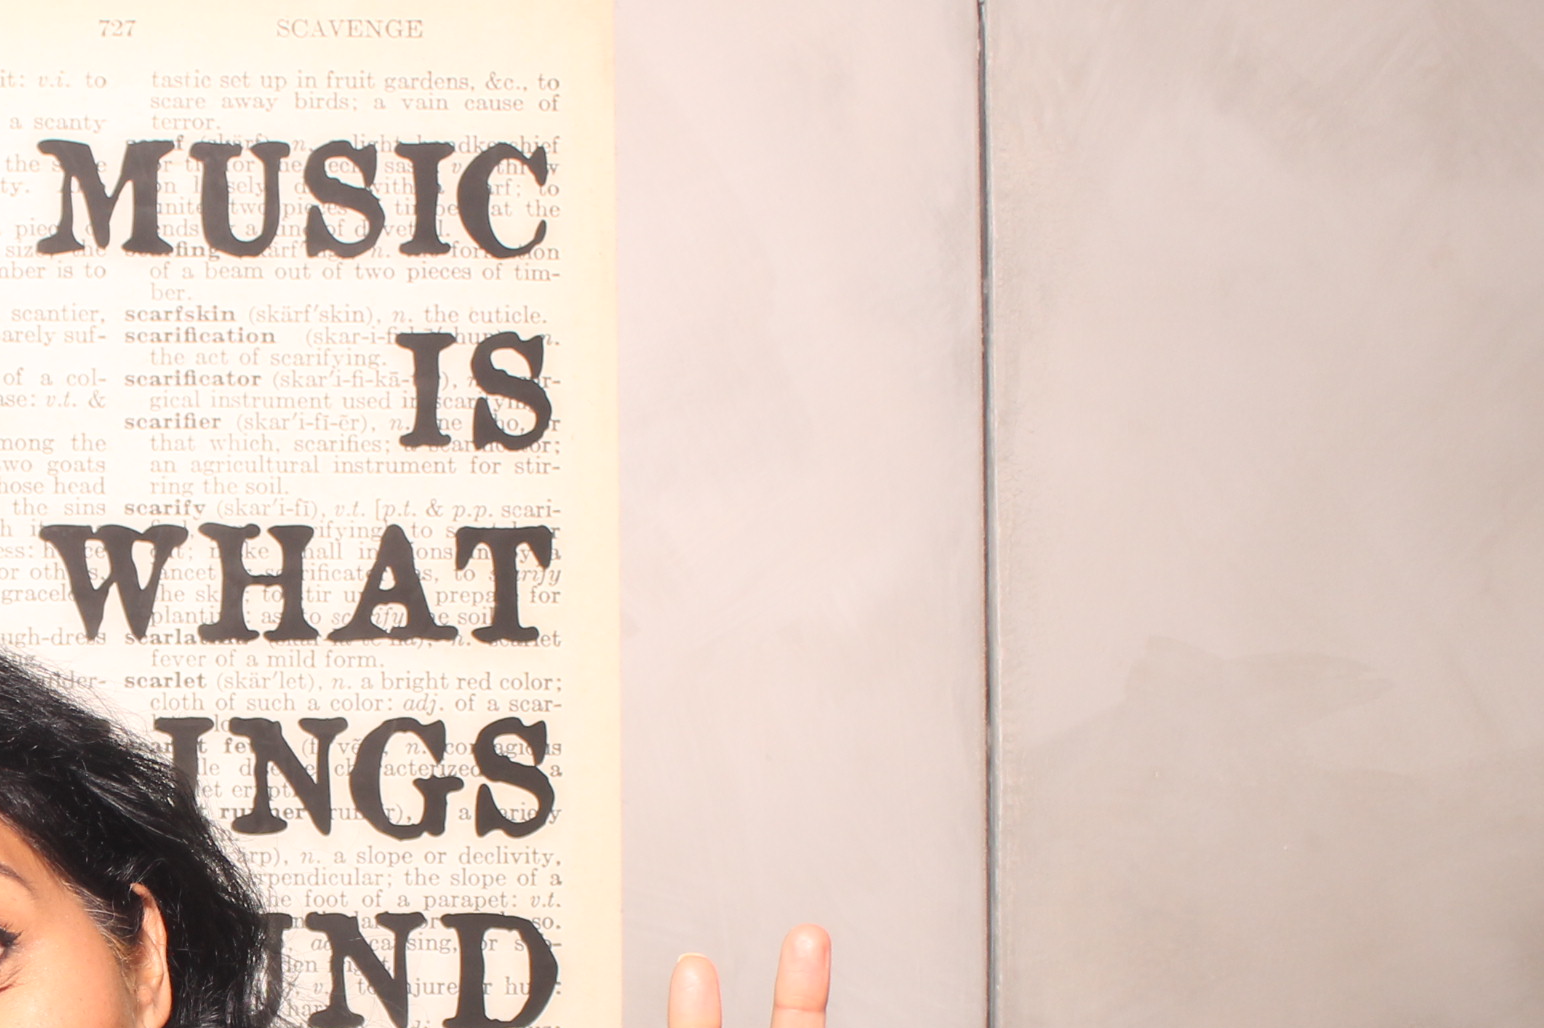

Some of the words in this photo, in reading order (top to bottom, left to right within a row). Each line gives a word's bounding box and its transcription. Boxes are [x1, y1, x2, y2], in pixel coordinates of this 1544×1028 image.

[98, 19, 136, 38] 727
[277, 19, 424, 39] SCAVENGE
[85, 72, 108, 88] to
[152, 69, 212, 88] tastic
[219, 71, 252, 88] set
[260, 75, 288, 94] up
[295, 70, 319, 89] in
[325, 70, 376, 90] fruit
[537, 73, 560, 91] to
[150, 96, 206, 110] scare
[221, 97, 279, 113] away
[401, 96, 450, 111] vain
[464, 98, 525, 112] cause
[538, 93, 561, 112] of
[9, 117, 23, 130] a
[33, 115, 107, 134] scanty
[6, 155, 39, 173] the
[36, 139, 548, 258] MUSIC
[56, 260, 74, 279] is
[84, 262, 107, 279] to
[149, 261, 173, 280] of
[182, 267, 195, 280] a
[204, 261, 264, 280] beam
[274, 263, 310, 280] out
[321, 261, 345, 280] of
[354, 263, 395, 280] two
[406, 264, 472, 284] pieces
[481, 262, 504, 280] of
[125, 305, 237, 322] scarfskin
[423, 306, 459, 323] the
[125, 327, 276, 344] scarification
[149, 347, 185, 366] the
[195, 349, 229, 366] act
[239, 347, 261, 366] of
[3, 367, 24, 386] of
[124, 369, 262, 387] scarificator
[88, 391, 106, 408] &
[395, 331, 552, 451] IS
[150, 391, 201, 412] gical
[211, 392, 332, 410] instrument
[342, 391, 392, 410] used
[125, 413, 221, 430] scarifier
[71, 433, 108, 452] the
[149, 434, 198, 452] that
[46, 457, 106, 477] goats
[150, 460, 177, 473] an
[190, 455, 320, 480] agricultural
[333, 456, 457, 474] instrument
[470, 456, 502, 474] for
[54, 476, 106, 495] head
[150, 481, 194, 499] ring
[202, 478, 238, 495] the
[6, 497, 39, 516] the
[64, 499, 106, 516] sins
[124, 499, 205, 521] scarify
[425, 501, 443, 517] &
[38, 522, 554, 644] WHAT
[151, 650, 207, 668] fever
[215, 650, 237, 667] of
[266, 650, 317, 669] mild
[124, 672, 206, 688] scarlet
[360, 677, 374, 690] a
[380, 671, 448, 696] bright
[456, 672, 492, 691] red
[150, 693, 205, 711] cloth
[215, 693, 237, 711] of
[246, 693, 296, 712] such
[454, 694, 476, 712] of
[486, 699, 500, 712] a
[155, 716, 555, 840] INGS
[355, 845, 413, 870] slope
[423, 850, 447, 864] or
[403, 868, 440, 886] the
[451, 868, 506, 890] slope
[516, 868, 538, 886] of
[549, 873, 562, 886] a
[305, 890, 348, 908] foot
[362, 890, 383, 908] of
